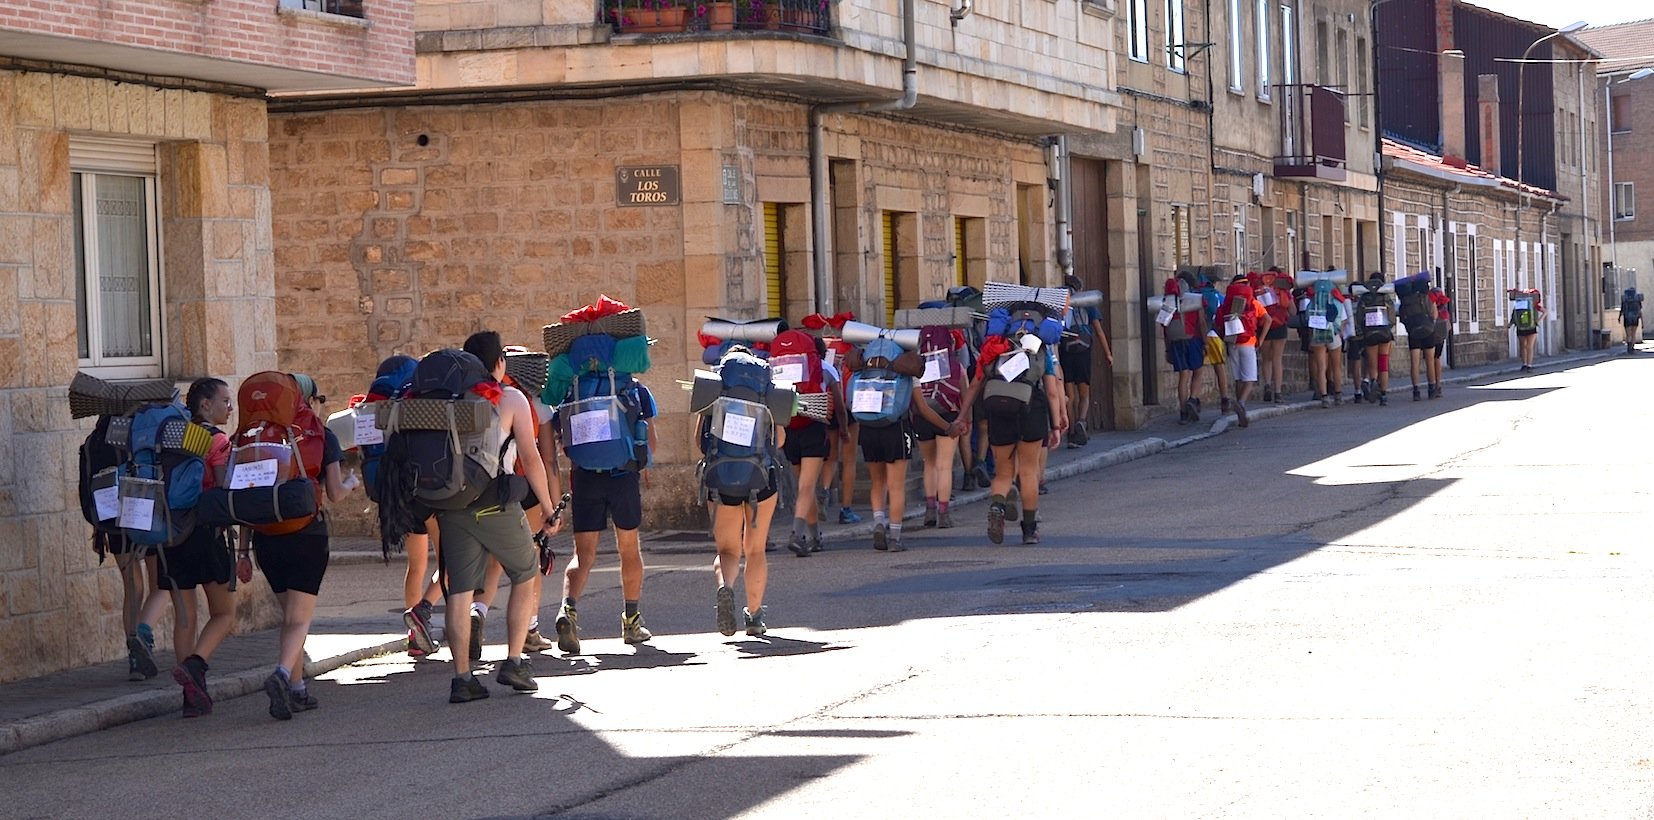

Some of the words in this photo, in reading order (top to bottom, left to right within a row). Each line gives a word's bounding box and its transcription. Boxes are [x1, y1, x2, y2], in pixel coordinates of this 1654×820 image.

[633, 169, 661, 177] CALLE
[637, 180, 659, 191] LOS
[630, 192, 667, 202] TOROS
